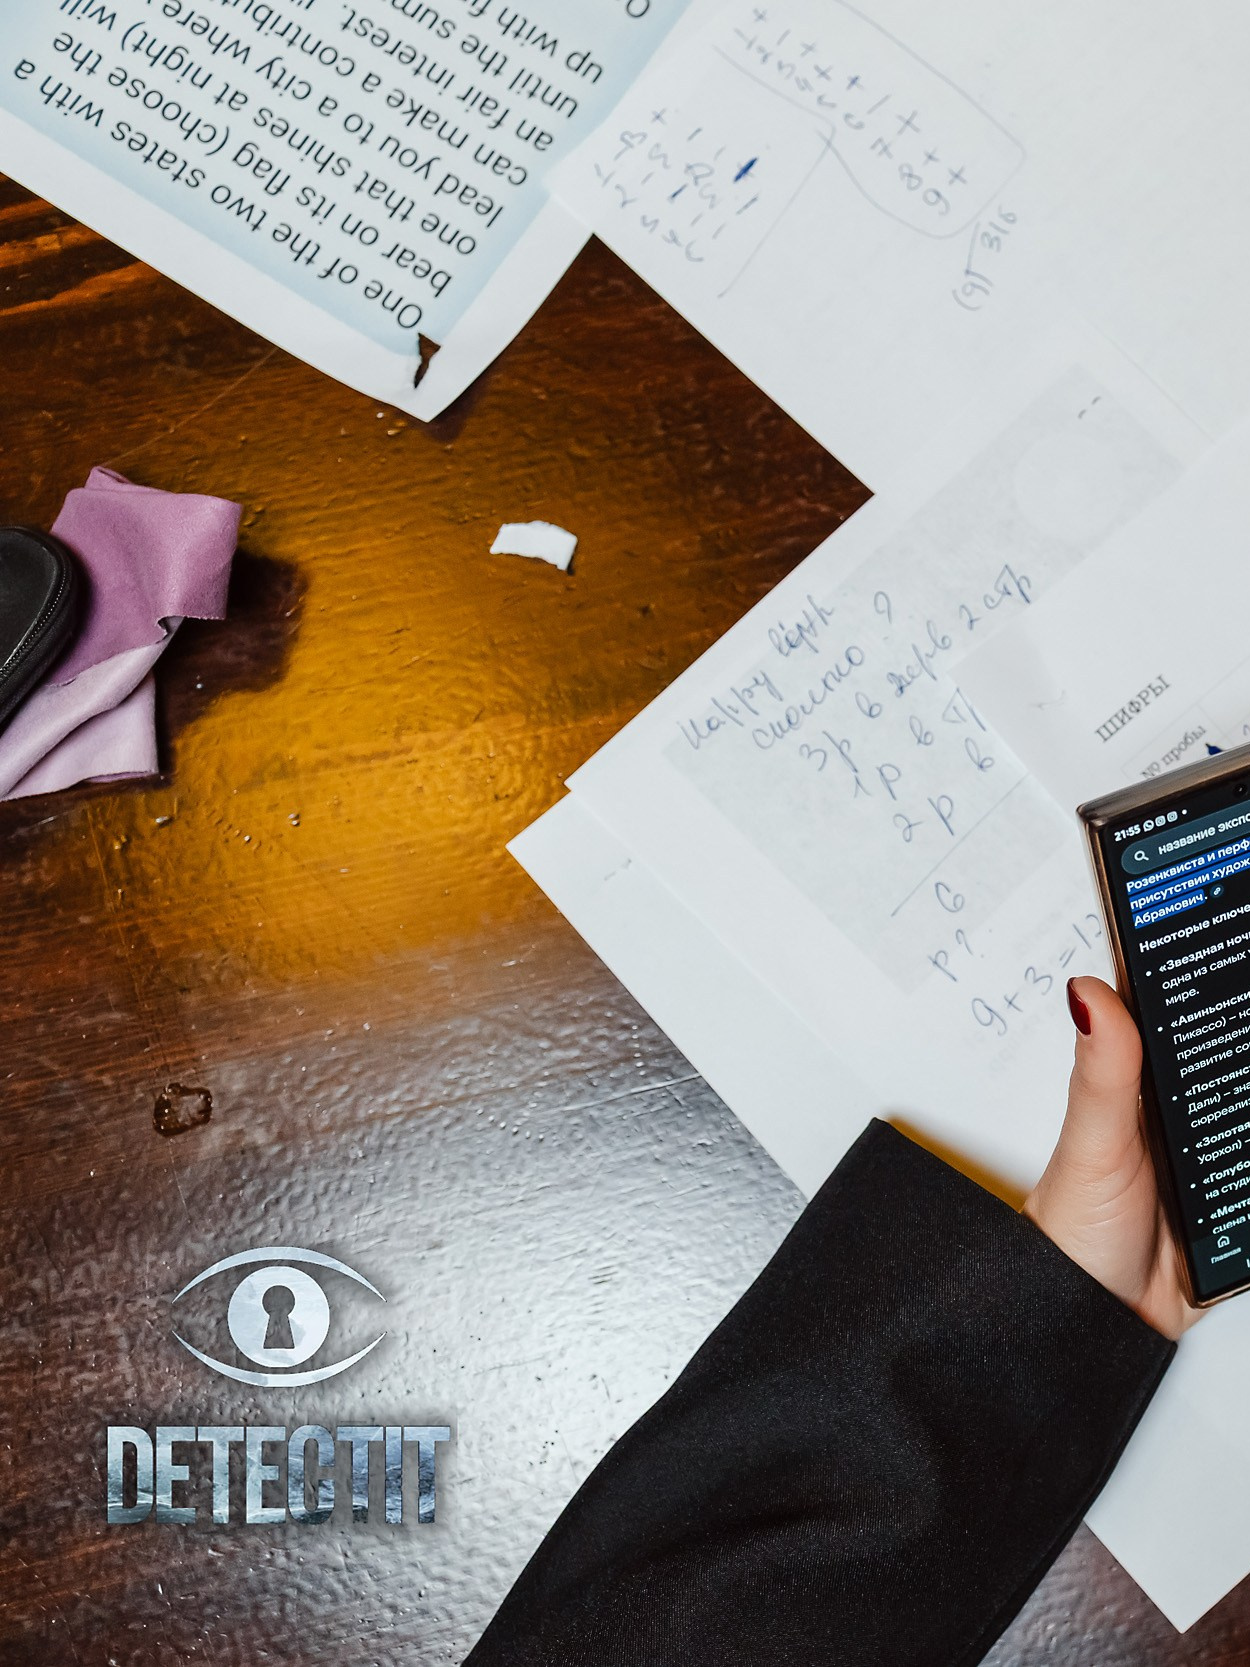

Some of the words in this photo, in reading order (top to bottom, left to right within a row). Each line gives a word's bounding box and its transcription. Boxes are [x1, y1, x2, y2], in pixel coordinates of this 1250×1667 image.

[162, 0, 251, 64] where
[341, 5, 455, 95] interest.
[497, 7, 558, 57] with
[13, 58, 36, 80] a
[52, 32, 102, 75] the
[121, 21, 213, 89] night)
[460, 34, 507, 76] the
[565, 51, 603, 83] up
[214, 82, 248, 111] at
[255, 56, 312, 100] city
[361, 72, 381, 93] a
[508, 68, 578, 118] until
[39, 75, 104, 127] with
[107, 67, 229, 156] (choose
[318, 96, 338, 116] a
[386, 89, 469, 149] make
[456, 86, 510, 129] fair
[253, 107, 351, 177] shines
[343, 113, 374, 145] to
[515, 119, 553, 151] an
[110, 121, 206, 188] states
[232, 142, 291, 196] flag
[378, 135, 440, 180] you
[473, 144, 527, 185] can
[210, 185, 267, 232] two
[296, 186, 336, 225] its
[354, 171, 415, 222] that
[433, 173, 503, 228] lead
[272, 223, 321, 265] the
[340, 213, 379, 246] on
[420, 213, 476, 255] one
[317, 257, 358, 284] of
[381, 243, 452, 298] bear
[363, 280, 422, 329] One
[1095, 675, 1170, 742] ШИФРЫ
[1161, 725, 1206, 766] пробы
[1114, 824, 1141, 842] 21:55
[1158, 826, 1216, 855] название
[1126, 856, 1205, 893] Розенквиста
[1206, 852, 1216, 862] и
[1130, 873, 1210, 910] присутствии
[1134, 893, 1208, 927] Абрамович.
[1139, 920, 1210, 953] Некоторые
[1158, 942, 1224, 972] «Звездная
[1161, 972, 1192, 990] одна
[1193, 966, 1208, 978] из
[1209, 950, 1247, 971] самых
[1165, 988, 1199, 1006] мире.
[1173, 1015, 1226, 1045] Пикассо)
[1179, 1049, 1233, 1078] развитие
[1187, 1092, 1221, 1115] Дали)
[1195, 1121, 1250, 1149] «Золотая
[1197, 1139, 1242, 1165] Уорхол)
[1205, 1189, 1220, 1200] на
[1212, 1215, 1246, 1234] сцена
